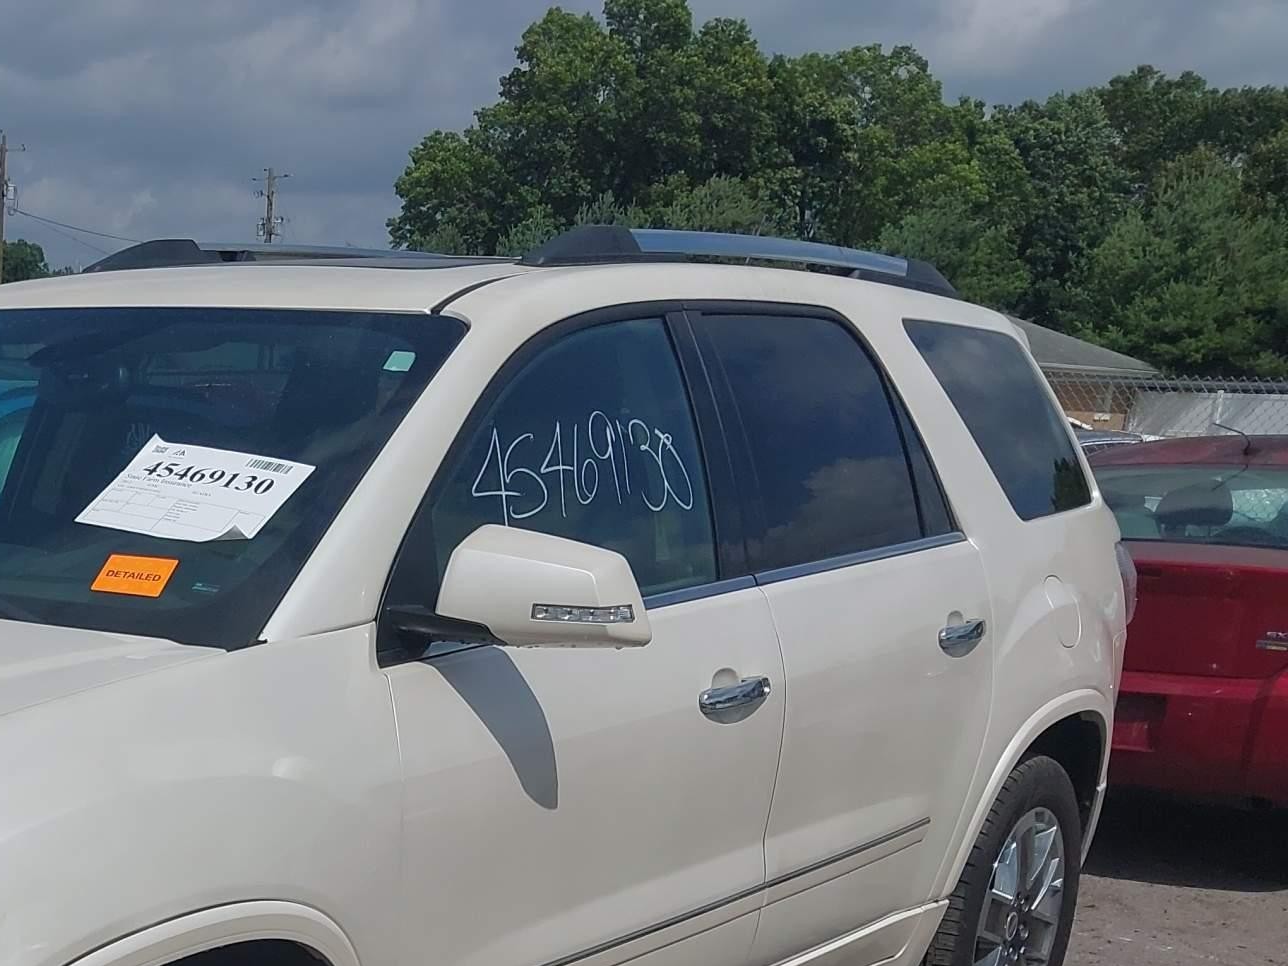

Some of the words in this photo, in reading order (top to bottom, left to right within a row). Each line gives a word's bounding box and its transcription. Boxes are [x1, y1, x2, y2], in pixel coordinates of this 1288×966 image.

[143, 461, 275, 495] 45469130
[472, 411, 693, 526] 45469130
[105, 569, 162, 582] DETAILED
